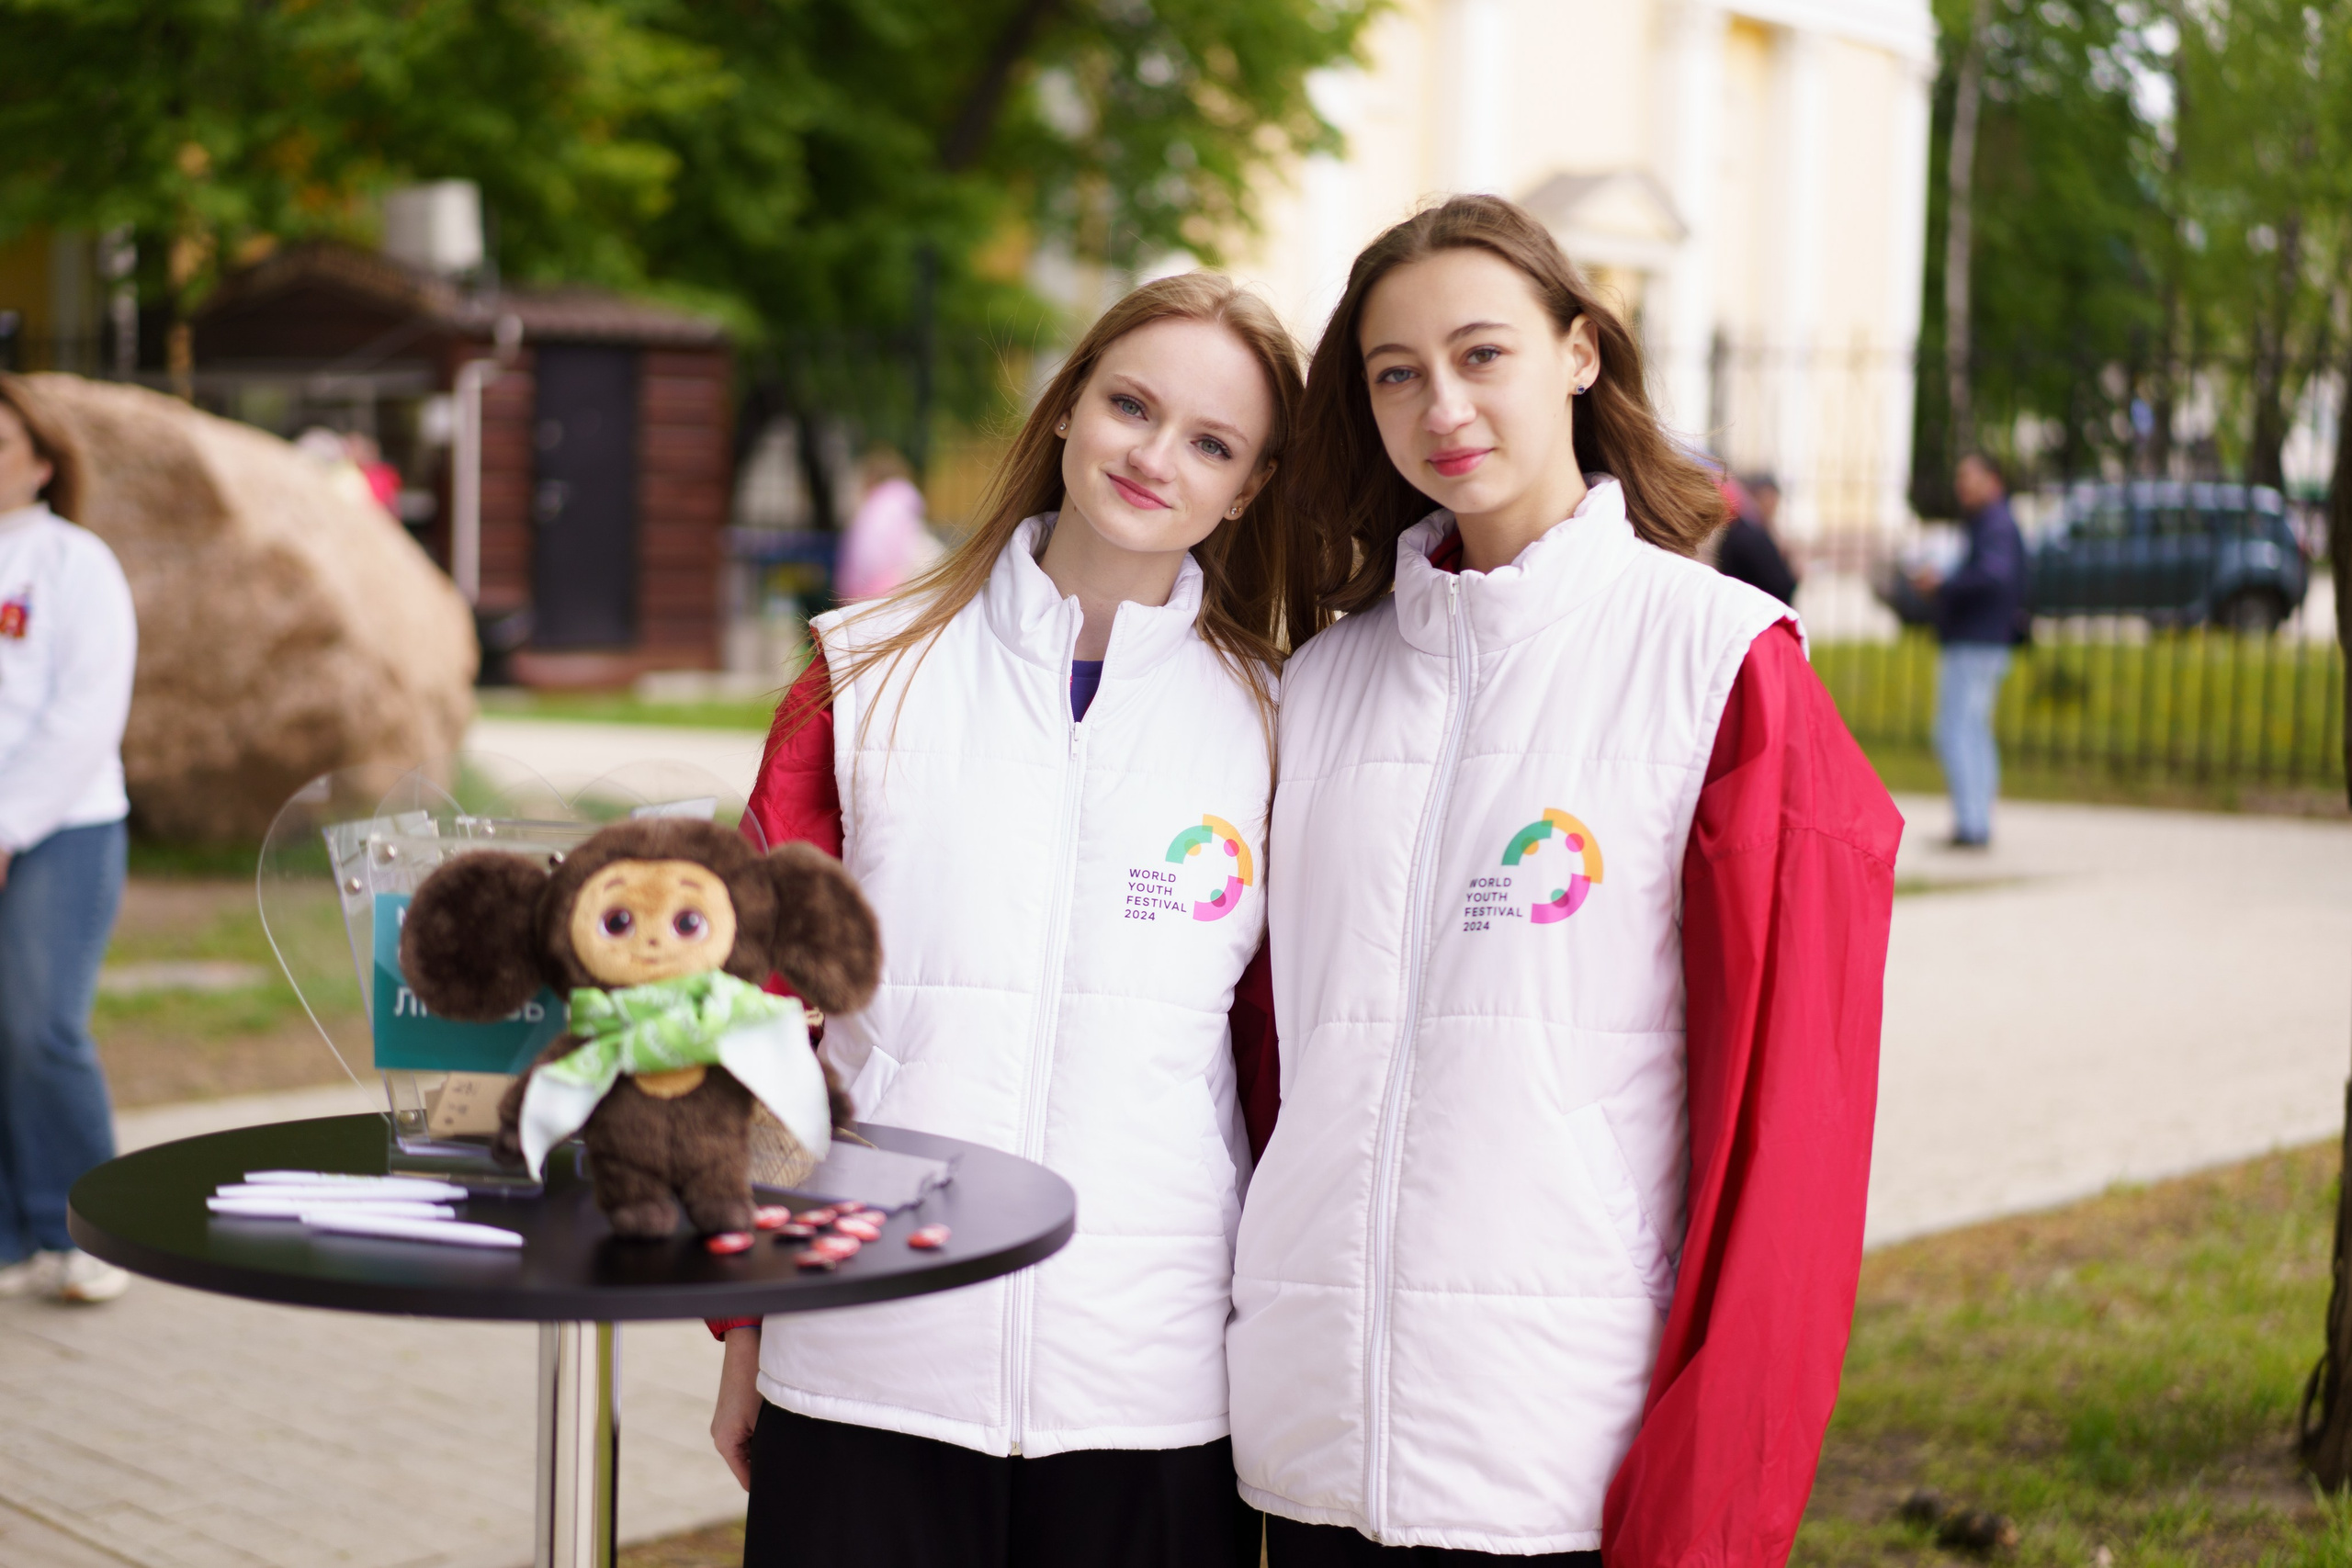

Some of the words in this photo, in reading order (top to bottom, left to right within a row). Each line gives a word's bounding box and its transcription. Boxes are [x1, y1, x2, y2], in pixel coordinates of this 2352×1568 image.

[1129, 868, 1176, 883] WORLD
[1469, 877, 1512, 887] WORLD
[1128, 882, 1172, 896] YOUTH
[1466, 892, 1508, 902] YOUTH
[1126, 896, 1187, 912] FESTIVAL
[1125, 908, 1155, 920] 2024
[1464, 906, 1522, 917] FESTIVAL
[1464, 921, 1489, 931] 2024
